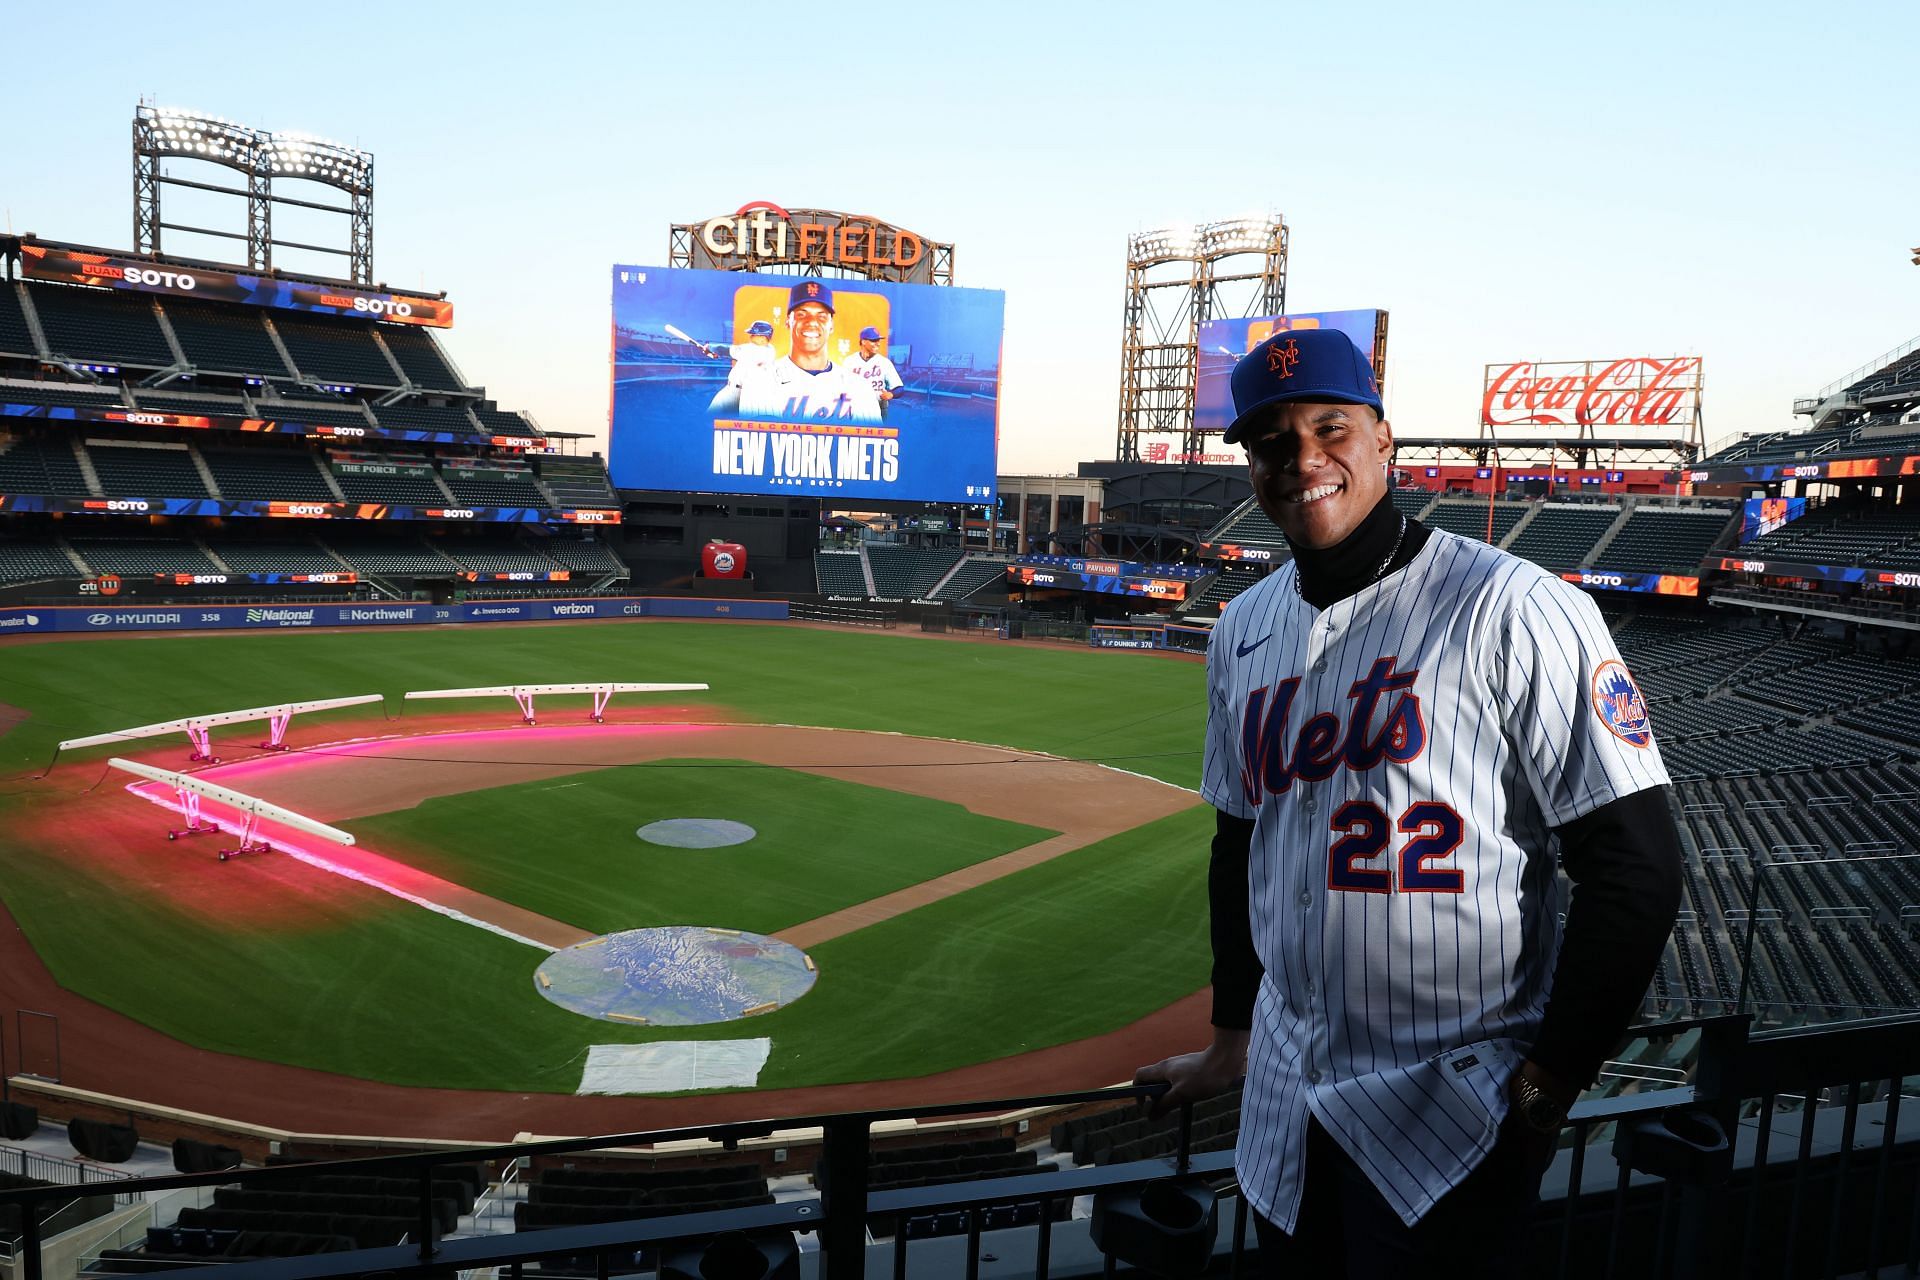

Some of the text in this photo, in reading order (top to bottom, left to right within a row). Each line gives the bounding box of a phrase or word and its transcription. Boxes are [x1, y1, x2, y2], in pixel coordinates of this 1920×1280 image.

[800, 223, 923, 267] FIELD
[83, 266, 196, 290] JUAN SOTO
[322, 295, 412, 317] JUAN SOTO
[126, 413, 164, 424] SOTO
[334, 427, 365, 436] SOTO
[733, 421, 884, 436] WELCOME TO THE
[713, 430, 899, 482] NEW YORK METS
[1171, 453, 1191, 461] new
[1193, 450, 1235, 462] balance
[341, 464, 397, 474] THE PORCH
[1794, 465, 1818, 476] SOTO
[107, 501, 149, 511] SOTO
[288, 505, 324, 515] SOTO
[443, 509, 473, 518] SOTO
[577, 513, 604, 521] SOTO
[1243, 550, 1270, 559] SOTO
[1086, 564, 1117, 573] PAVILION
[1743, 561, 1764, 572] SOTO
[193, 575, 227, 583] SOTO
[308, 574, 338, 582] SOTO
[1033, 574, 1054, 583] SOTO
[1582, 574, 1622, 586] SOTO
[1142, 584, 1166, 593] SOTO
[351, 608, 413, 620] Northwell
[553, 603, 595, 615] verizon
[623, 604, 641, 614] citi
[115, 614, 180, 624] HYUNDAI
[201, 614, 221, 622] 358
[262, 609, 314, 621] National
[1241, 655, 1427, 808] Mets
[1327, 800, 1465, 894] 22
